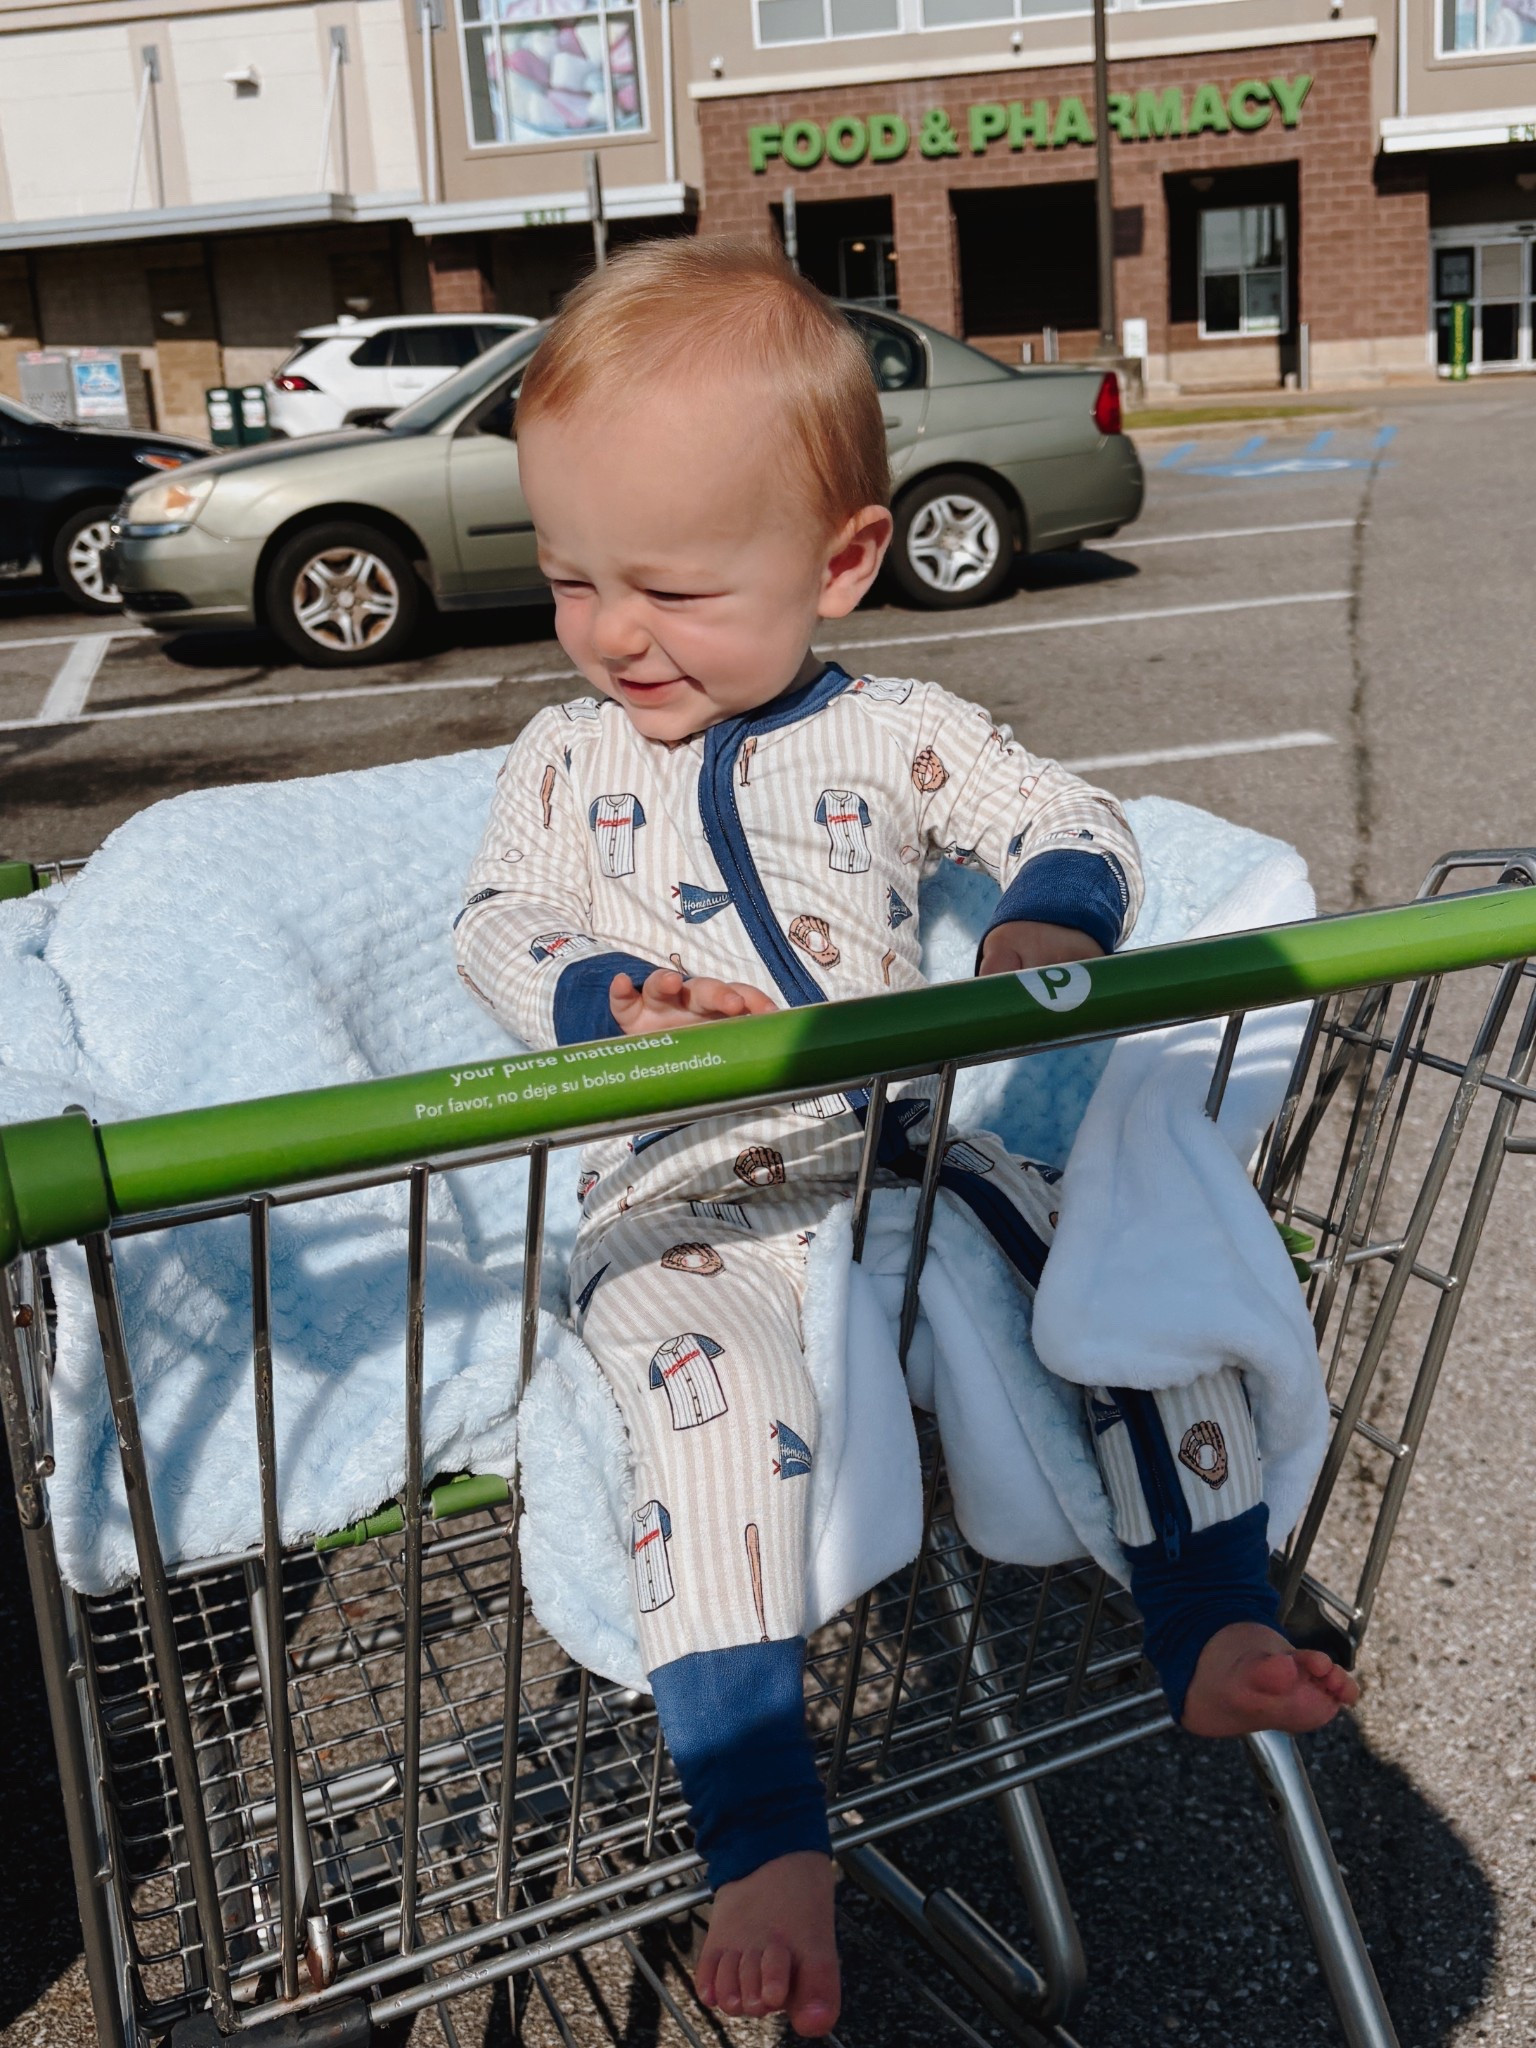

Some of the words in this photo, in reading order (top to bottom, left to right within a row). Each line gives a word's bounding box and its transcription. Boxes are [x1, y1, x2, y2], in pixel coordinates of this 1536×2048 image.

[748, 114, 910, 174] FOOD
[919, 107, 960, 158] &
[967, 74, 1314, 152] PHARMACY
[415, 1103, 443, 1119] Por
[448, 1096, 493, 1113] favor,
[497, 1091, 518, 1105] no
[522, 1083, 558, 1101] deje
[562, 1080, 579, 1093] su
[582, 1070, 626, 1089] bolso
[629, 1051, 727, 1080] desatendido.
[450, 1066, 495, 1087] your
[502, 1056, 558, 1079] purse
[563, 1033, 680, 1063] unattended.
